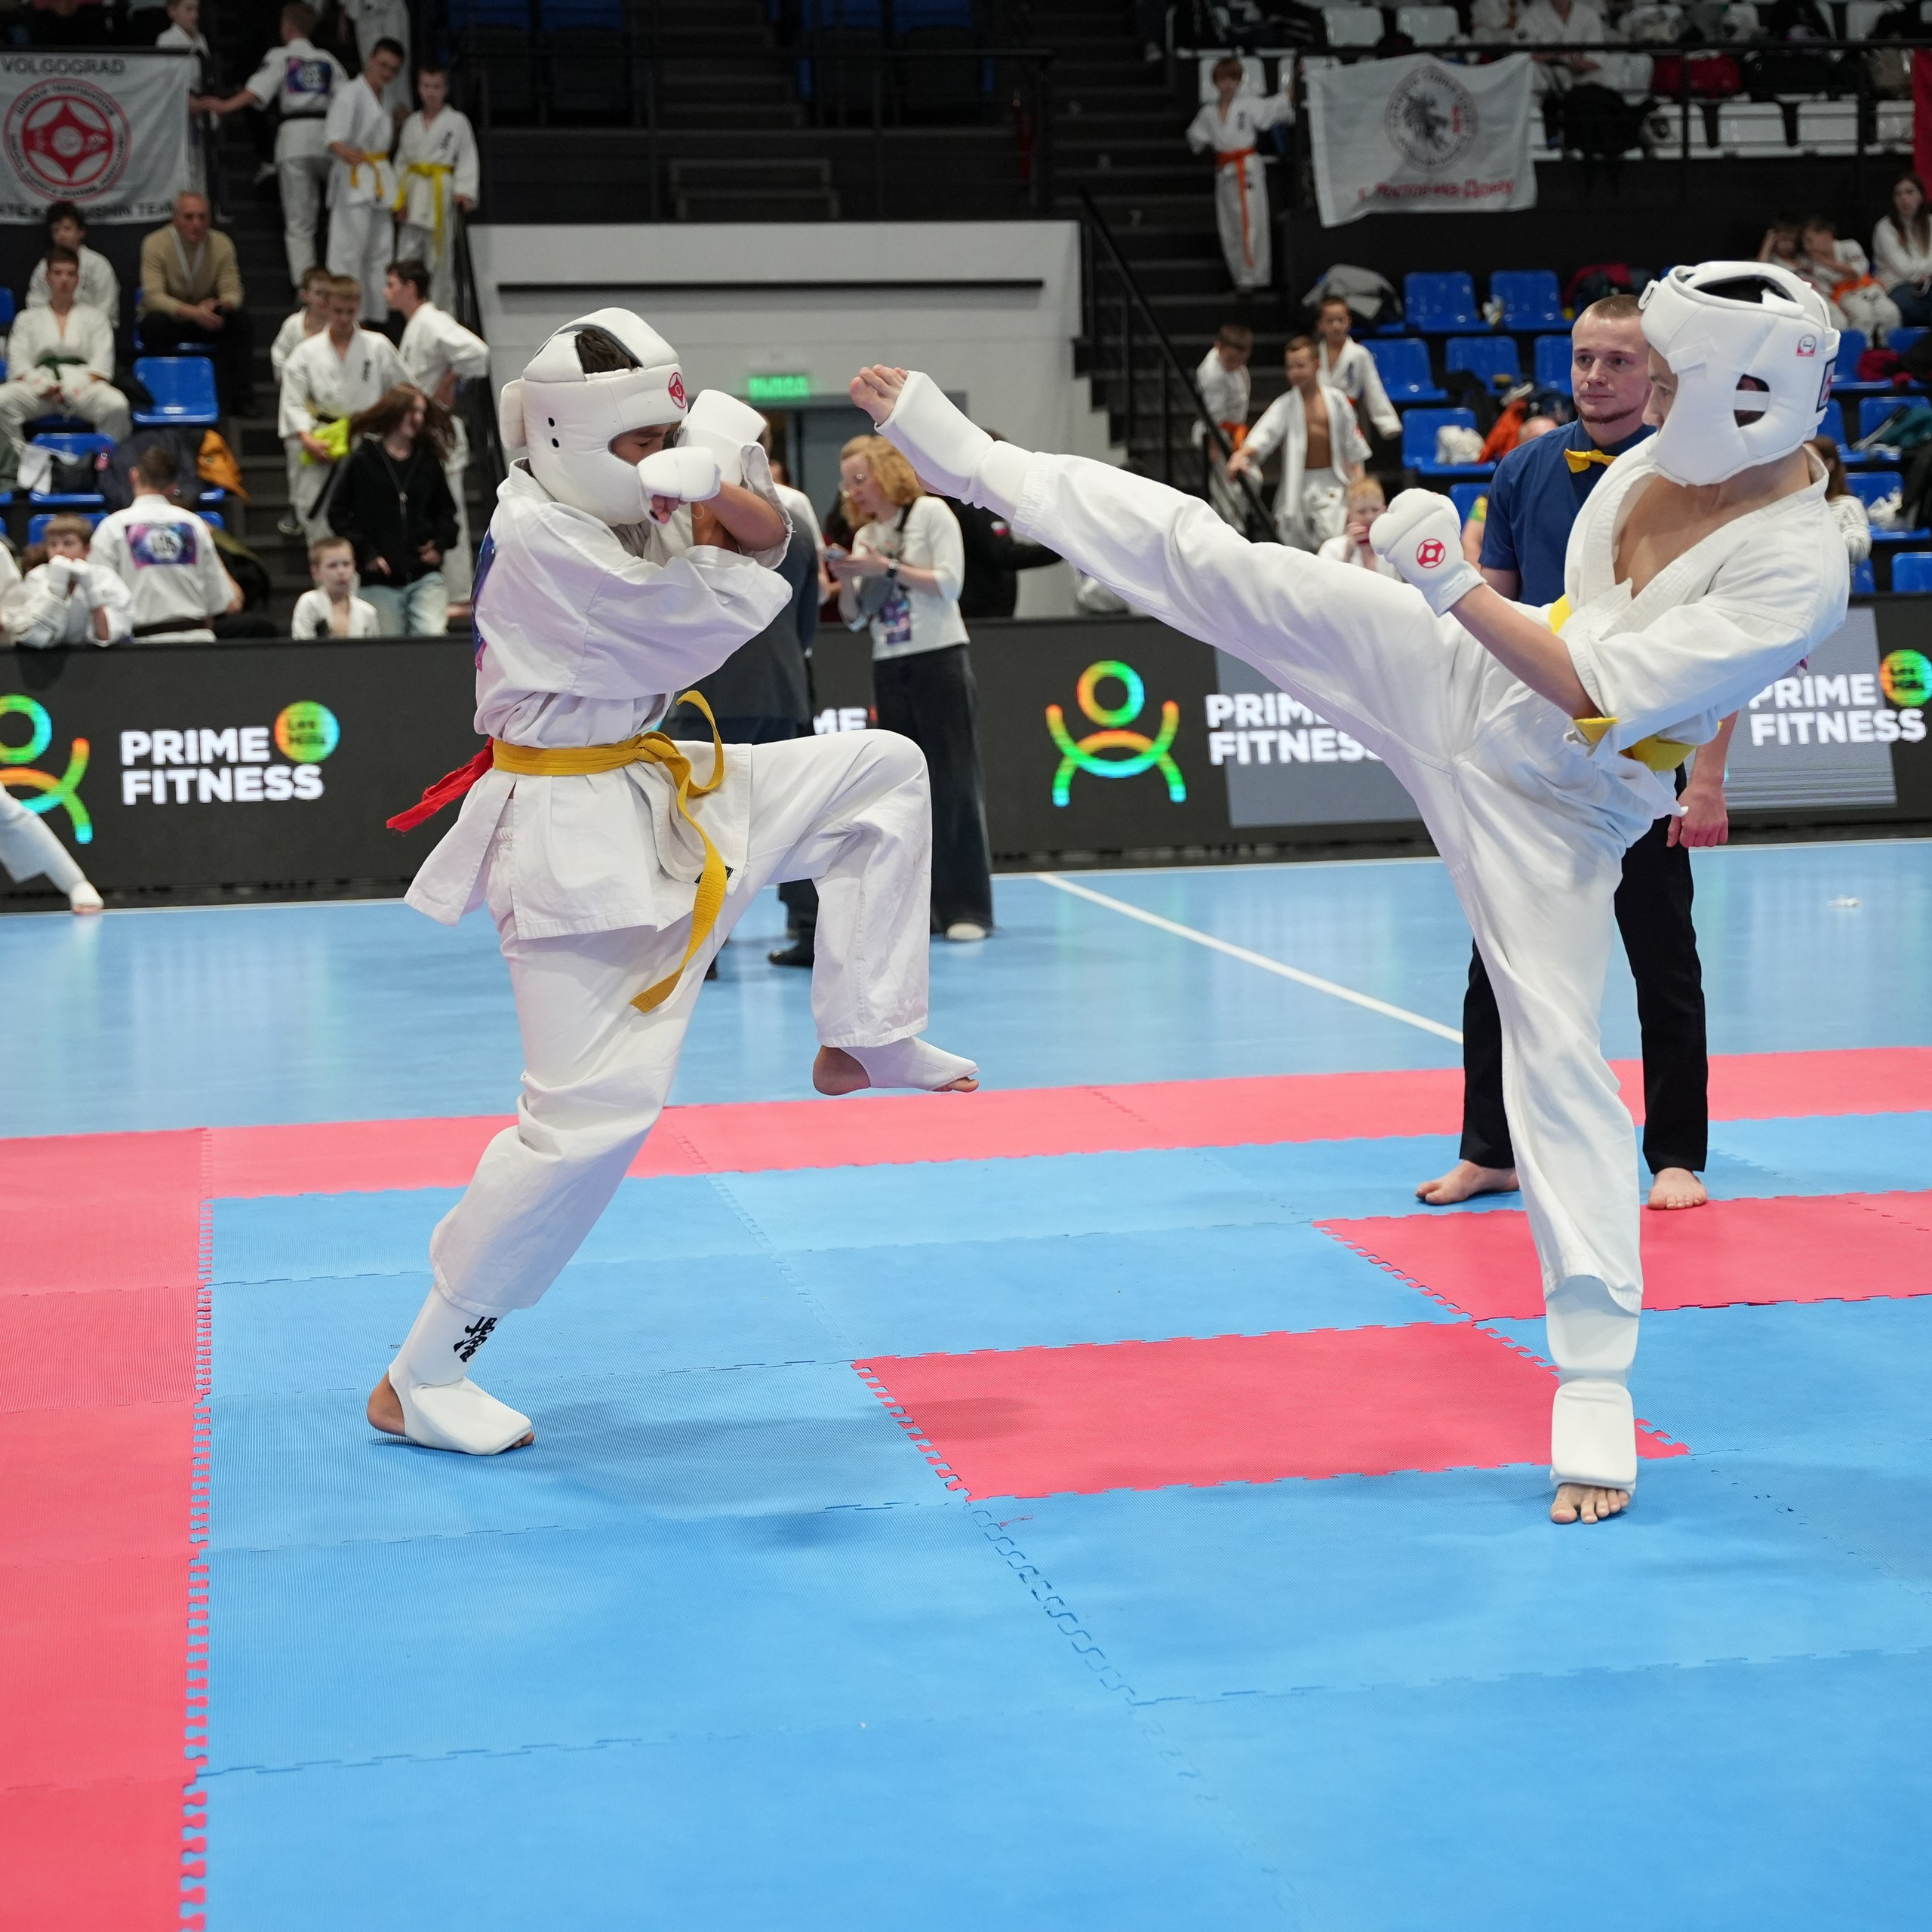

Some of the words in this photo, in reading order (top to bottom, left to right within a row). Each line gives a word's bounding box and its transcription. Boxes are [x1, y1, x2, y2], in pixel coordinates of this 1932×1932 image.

[2, 58, 126, 75] VOLGOGRAD
[1205, 692, 1332, 728] PRIM
[1749, 708, 1927, 746] FITNESS
[120, 726, 271, 766] PRIME
[1208, 727, 1383, 766] FITNES
[122, 764, 325, 806] FITNESS
